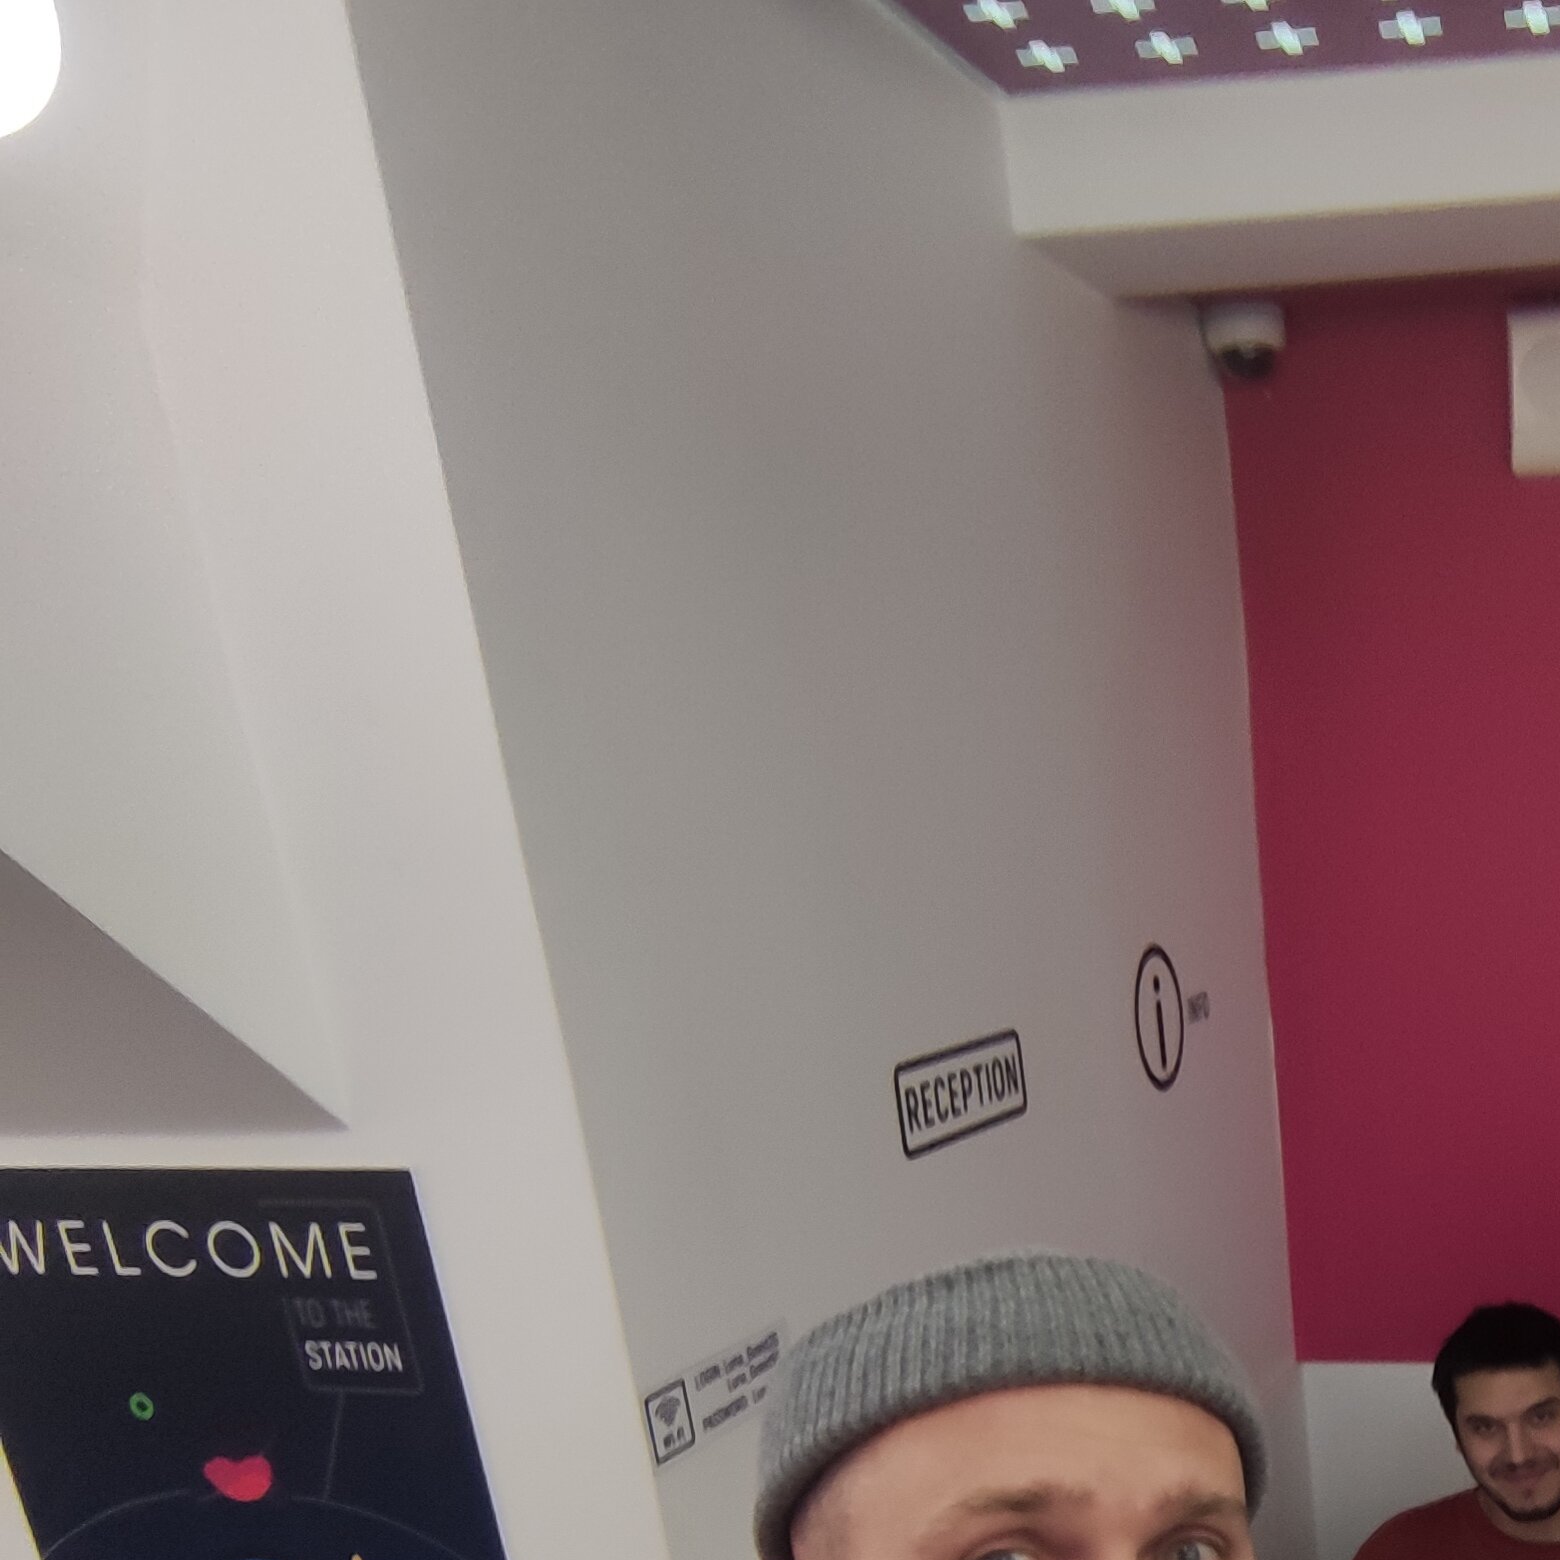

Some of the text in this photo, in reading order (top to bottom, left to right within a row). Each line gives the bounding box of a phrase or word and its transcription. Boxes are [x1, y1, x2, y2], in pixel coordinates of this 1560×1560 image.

[905, 1053, 1019, 1134] RECEPTION
[0, 1219, 378, 1281] WELCOME
[331, 1300, 377, 1330] THE
[304, 1339, 403, 1373] STATION
